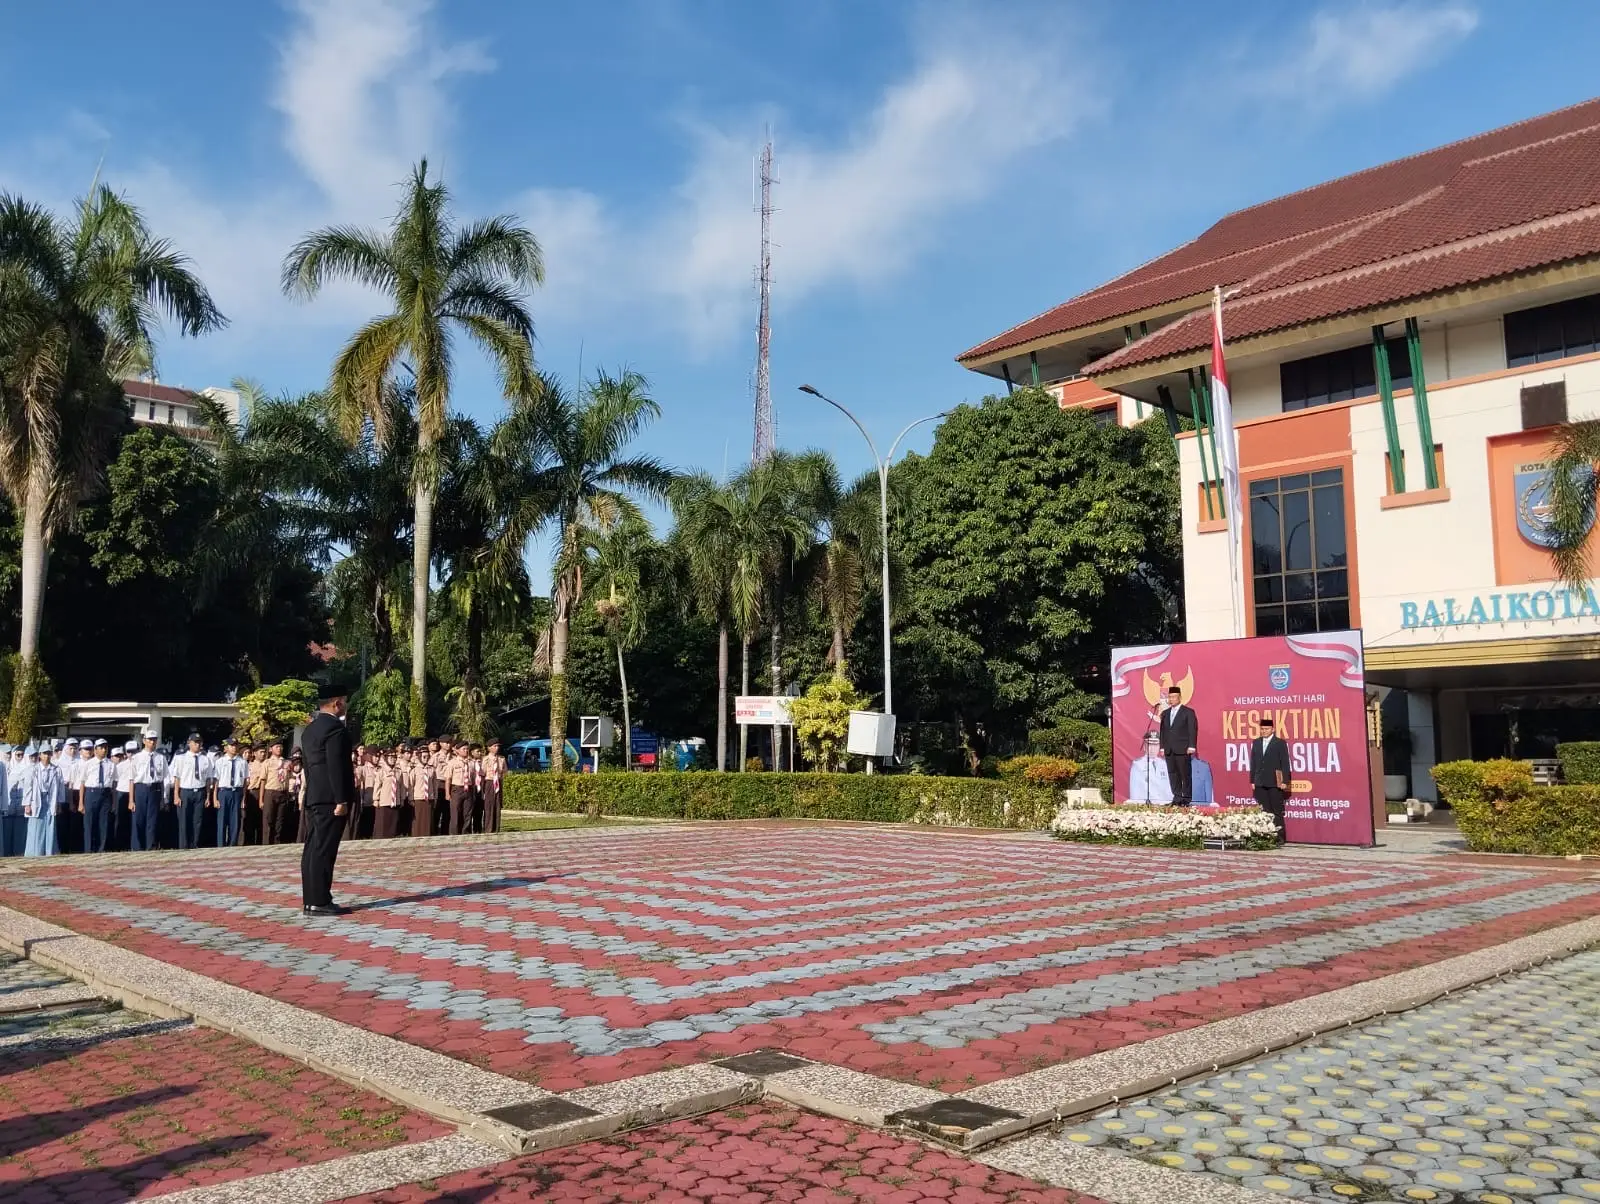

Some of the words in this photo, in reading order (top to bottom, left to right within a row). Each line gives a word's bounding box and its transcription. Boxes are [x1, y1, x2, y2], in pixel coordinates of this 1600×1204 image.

[1234, 695, 1300, 705] MEMPERINGATI
[1304, 694, 1324, 703] HARI
[1226, 742, 1341, 772] PASILA
[1313, 797, 1350, 809] Bangsa
[1316, 810, 1343, 821] Raya"
